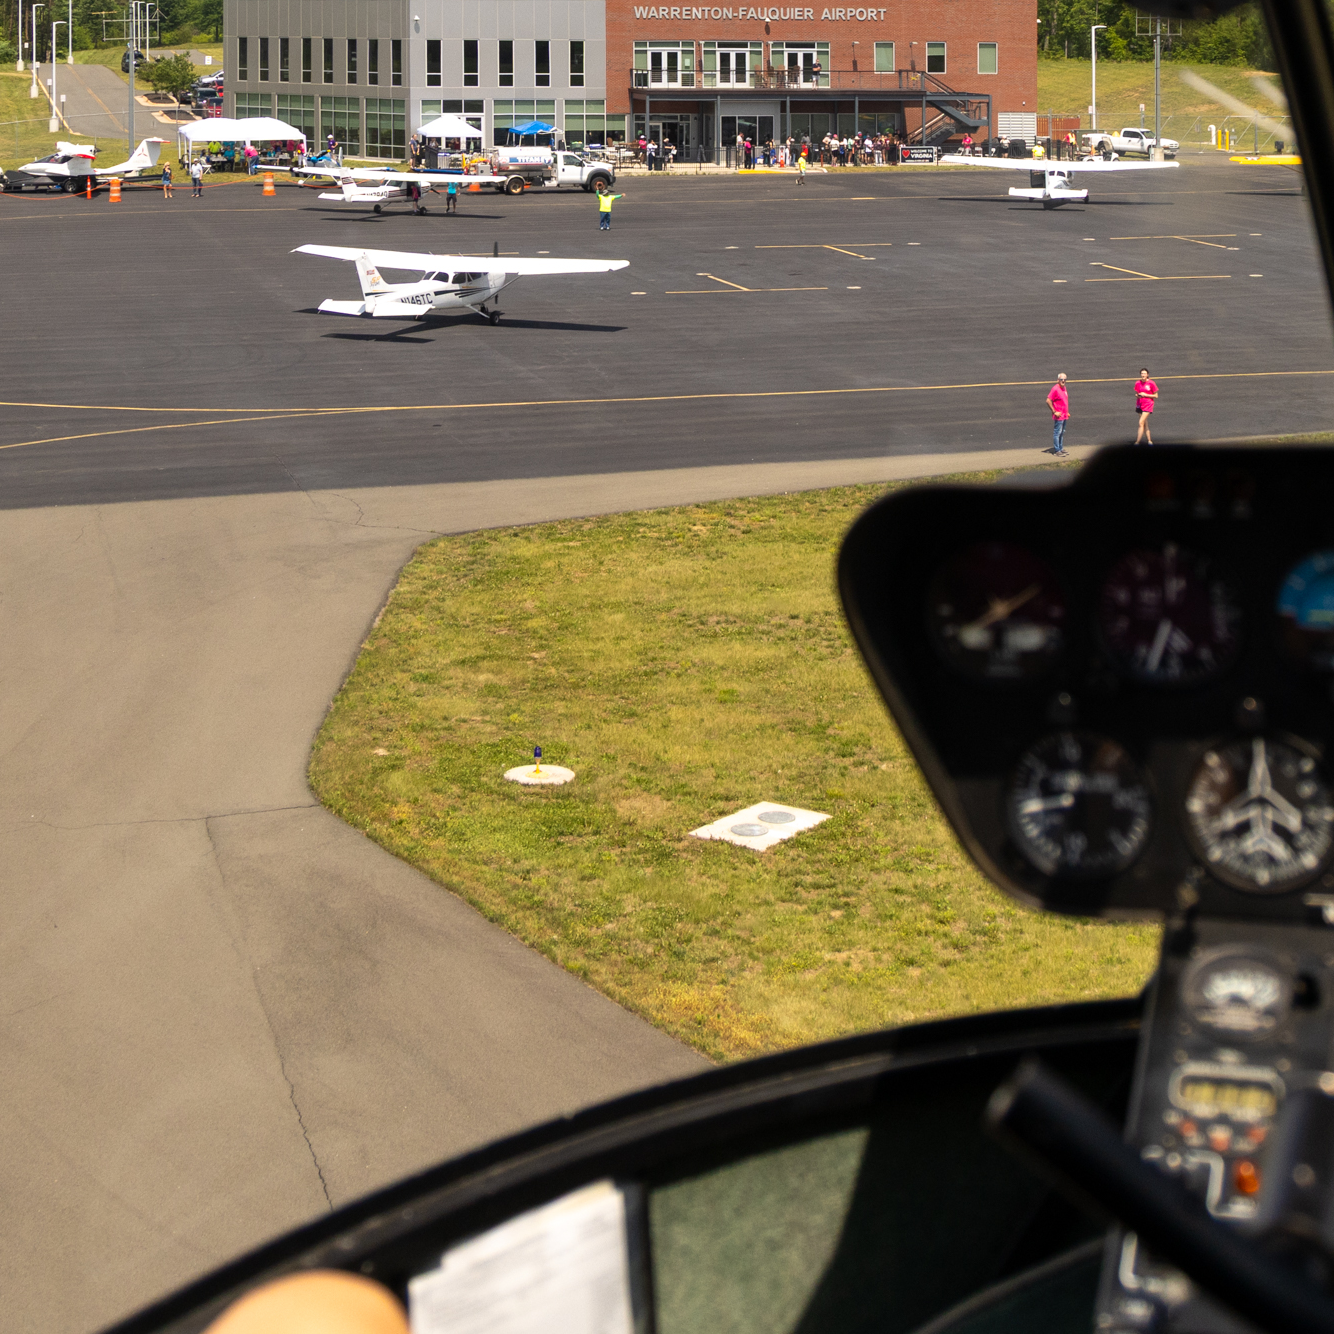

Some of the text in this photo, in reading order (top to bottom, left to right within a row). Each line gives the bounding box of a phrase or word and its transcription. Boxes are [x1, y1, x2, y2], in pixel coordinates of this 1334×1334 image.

[634, 6, 887, 21] WARRENTON-FAUQUIER AIRPORT
[400, 293, 433, 305] N146TC
